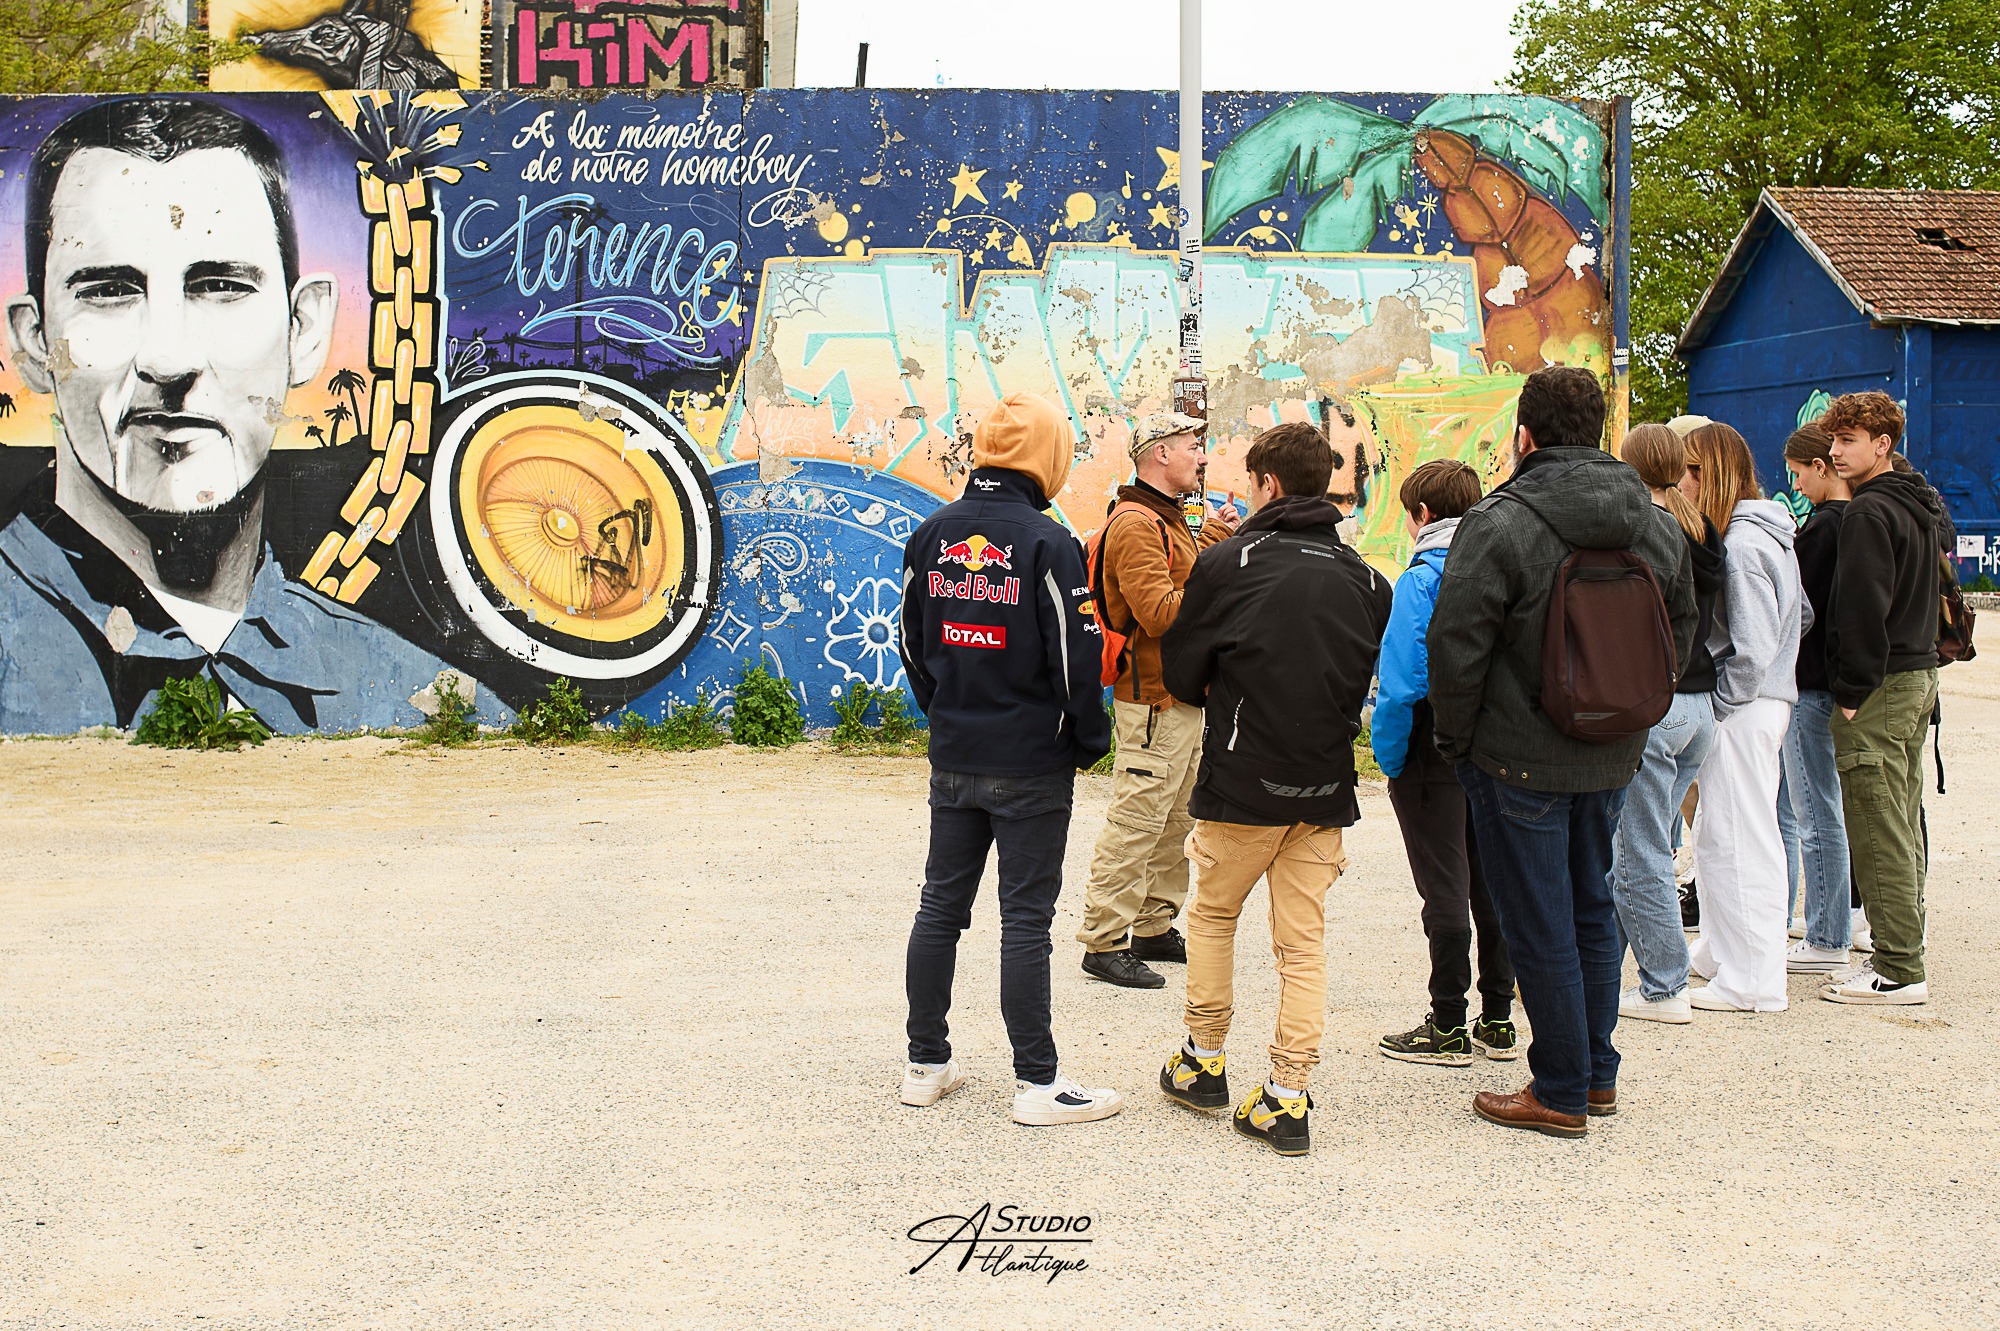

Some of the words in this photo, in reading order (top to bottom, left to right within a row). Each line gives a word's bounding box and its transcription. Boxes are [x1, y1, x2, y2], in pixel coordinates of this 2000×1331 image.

[512, 110, 555, 148] A
[568, 109, 607, 148] la
[617, 114, 748, 153] mémoire
[521, 149, 562, 184] de
[571, 150, 649, 186] notre
[660, 134, 813, 228] homeboy
[943, 624, 1001, 645] TOTAL
